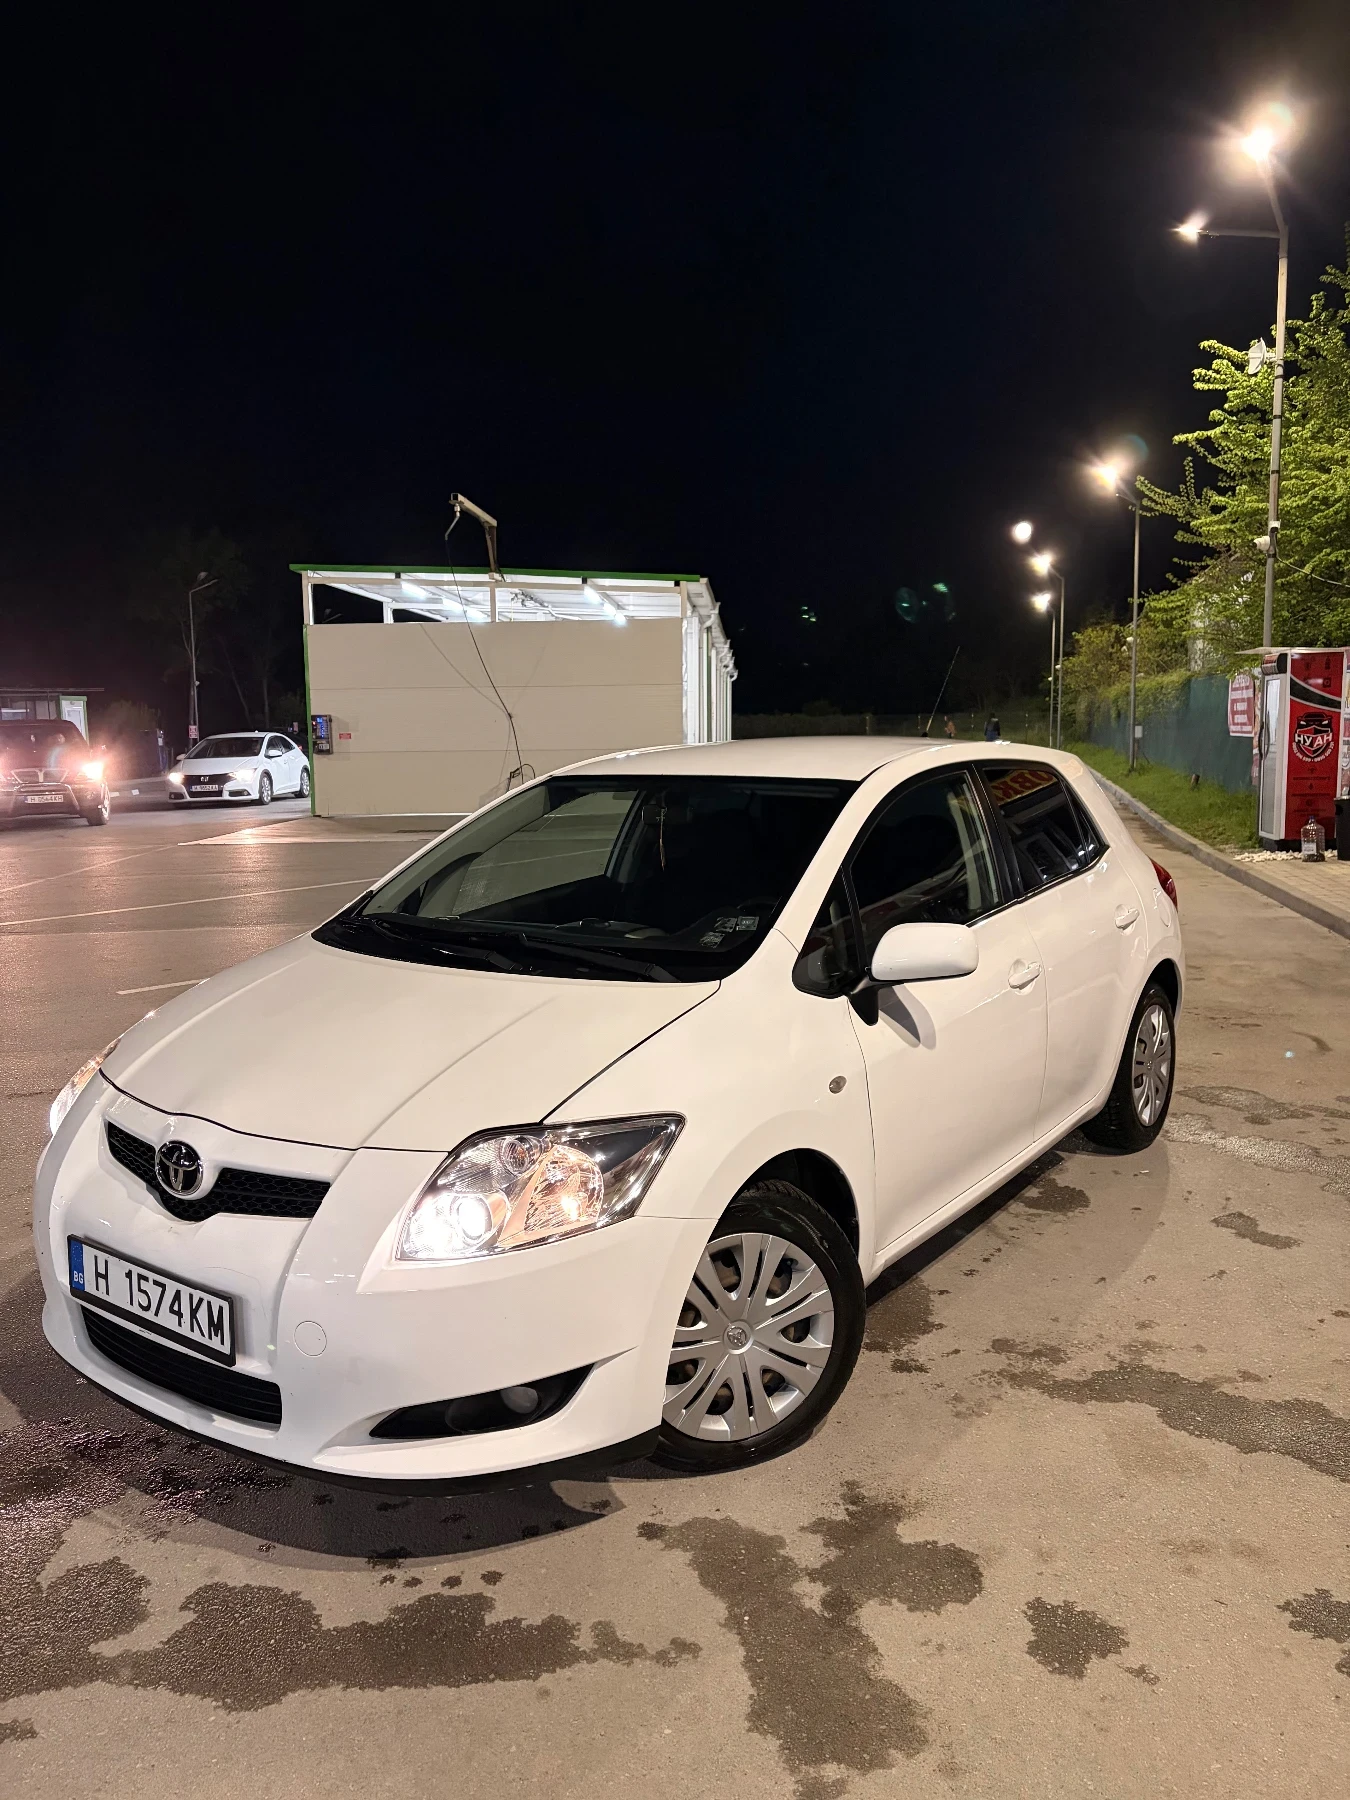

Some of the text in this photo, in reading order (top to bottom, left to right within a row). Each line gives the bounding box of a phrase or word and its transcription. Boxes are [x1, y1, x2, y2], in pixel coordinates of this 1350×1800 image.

[73, 1270, 84, 1284] BG
[94, 1254, 225, 1347] H 1574KM
